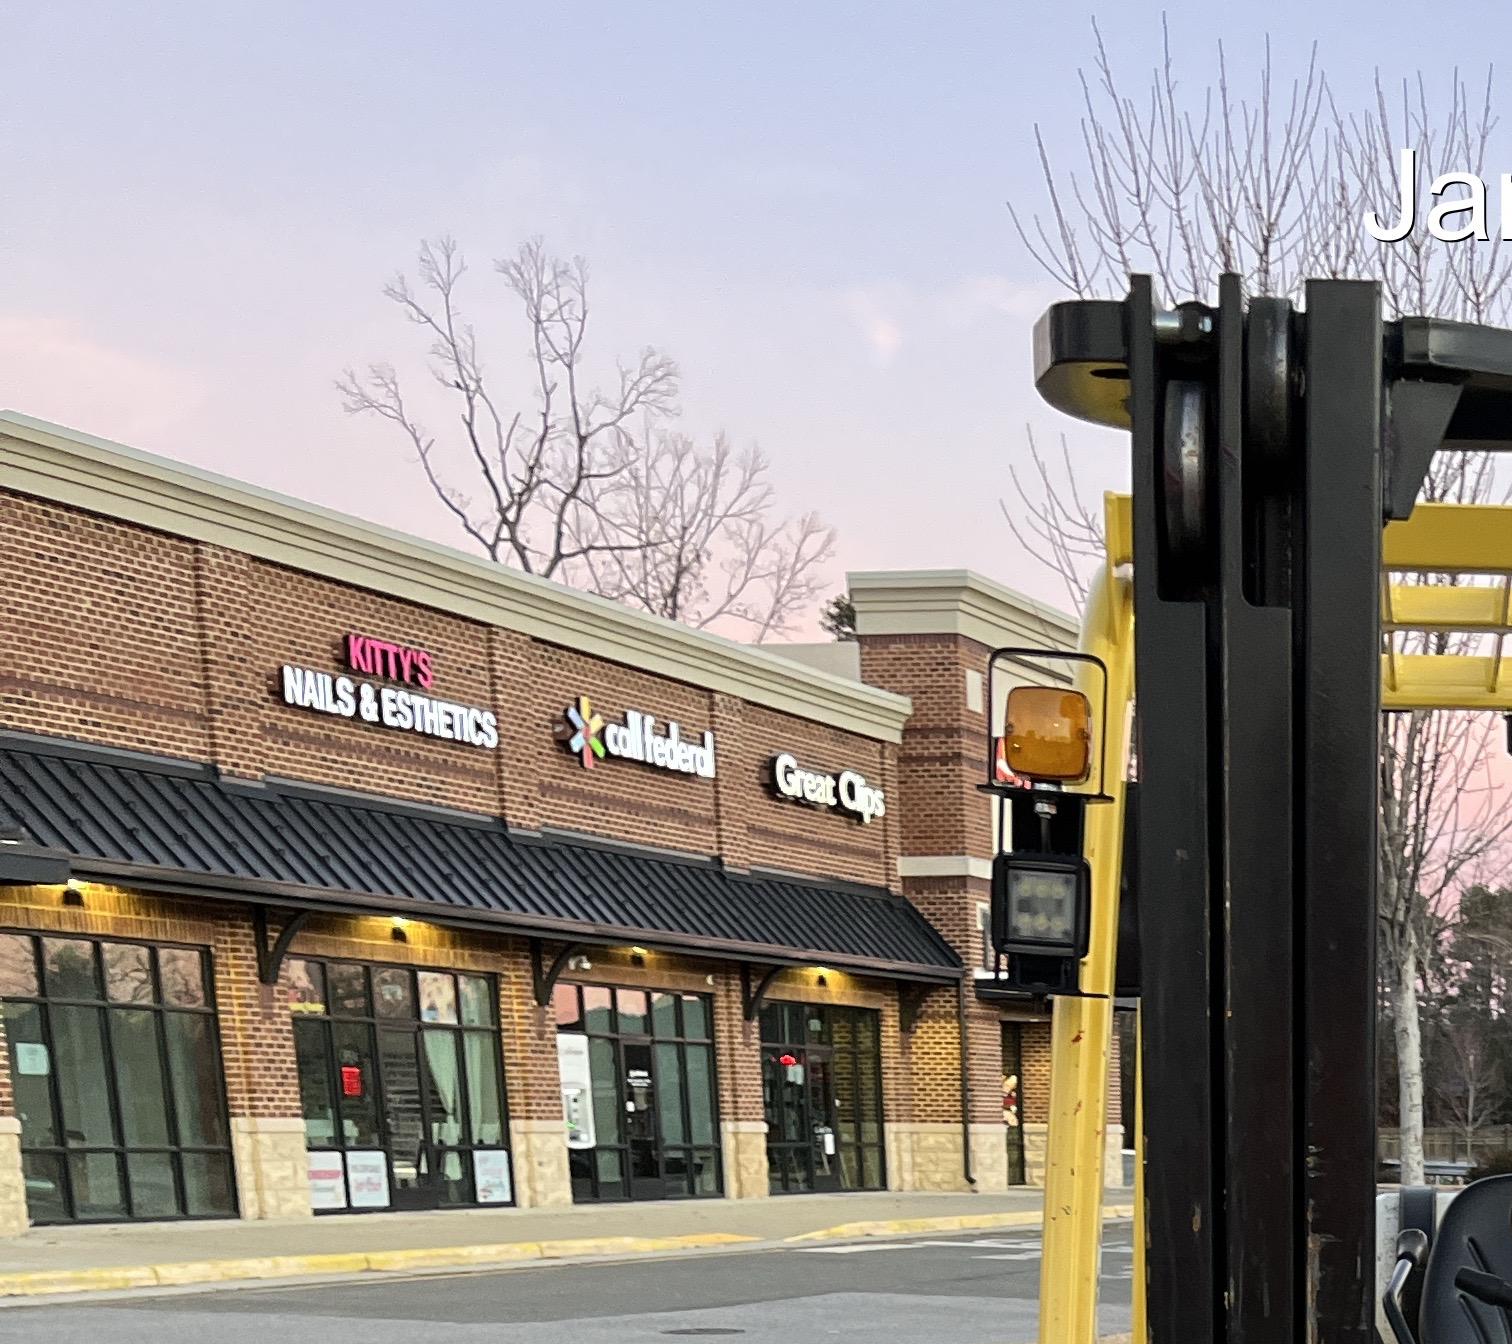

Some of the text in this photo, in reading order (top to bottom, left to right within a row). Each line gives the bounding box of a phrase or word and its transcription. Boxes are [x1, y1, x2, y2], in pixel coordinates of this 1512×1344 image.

[348, 634, 433, 690] KITTY'S
[282, 664, 499, 749] NAILS & ESTHETICS
[775, 753, 886, 824] Great Clips
